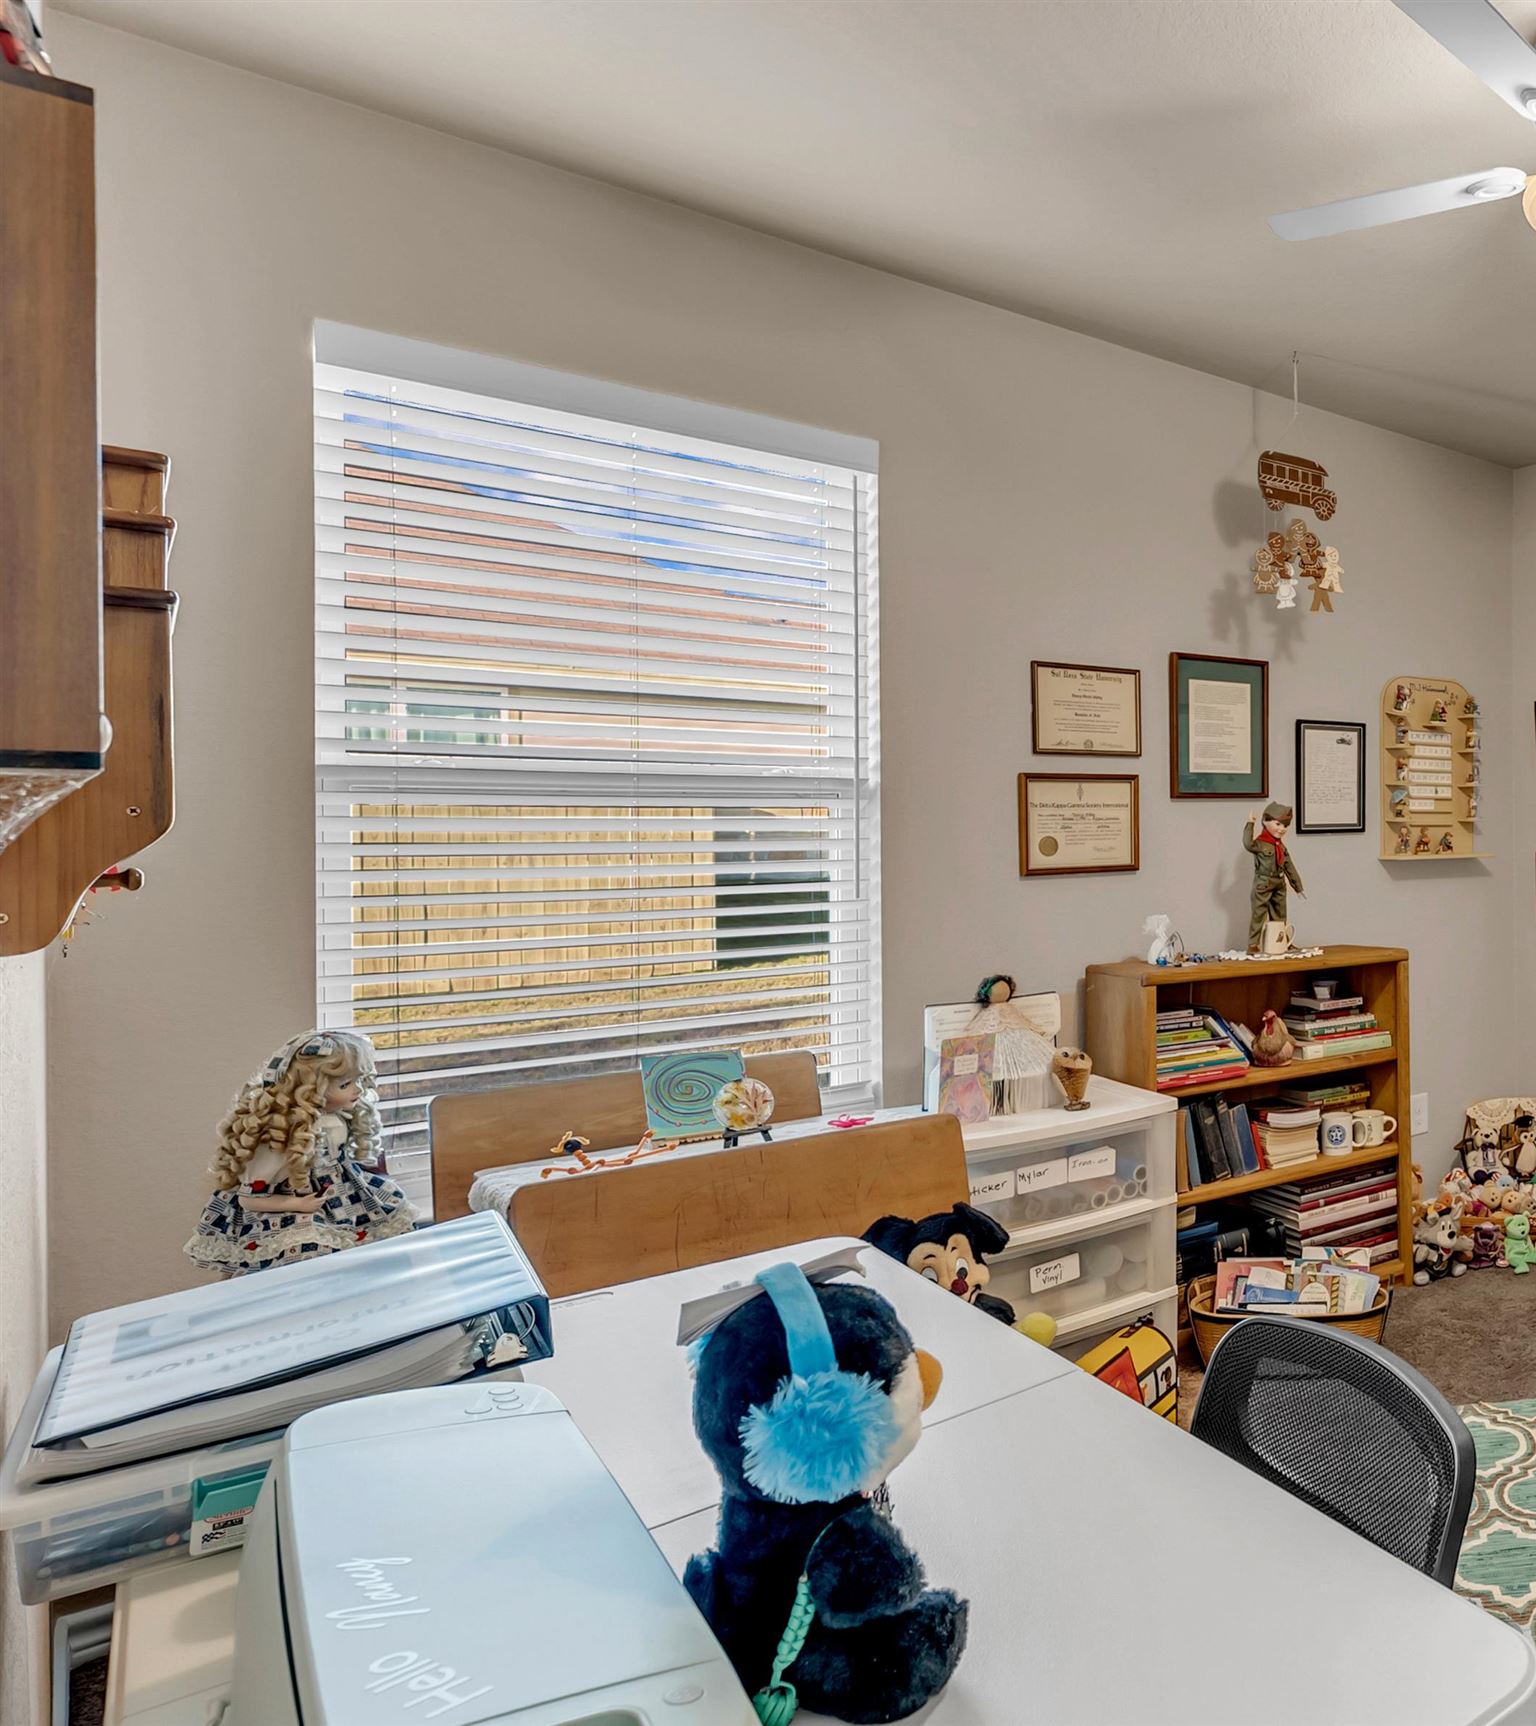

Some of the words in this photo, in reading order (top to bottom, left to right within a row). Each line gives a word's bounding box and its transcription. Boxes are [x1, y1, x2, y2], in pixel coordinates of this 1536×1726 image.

[1018, 1168, 1050, 1185] Mylar
[970, 1180, 1007, 1196] ticker
[1034, 1262, 1062, 1278] Perm
[324, 1556, 432, 1630] Nancy
[364, 1650, 495, 1719] Hello
